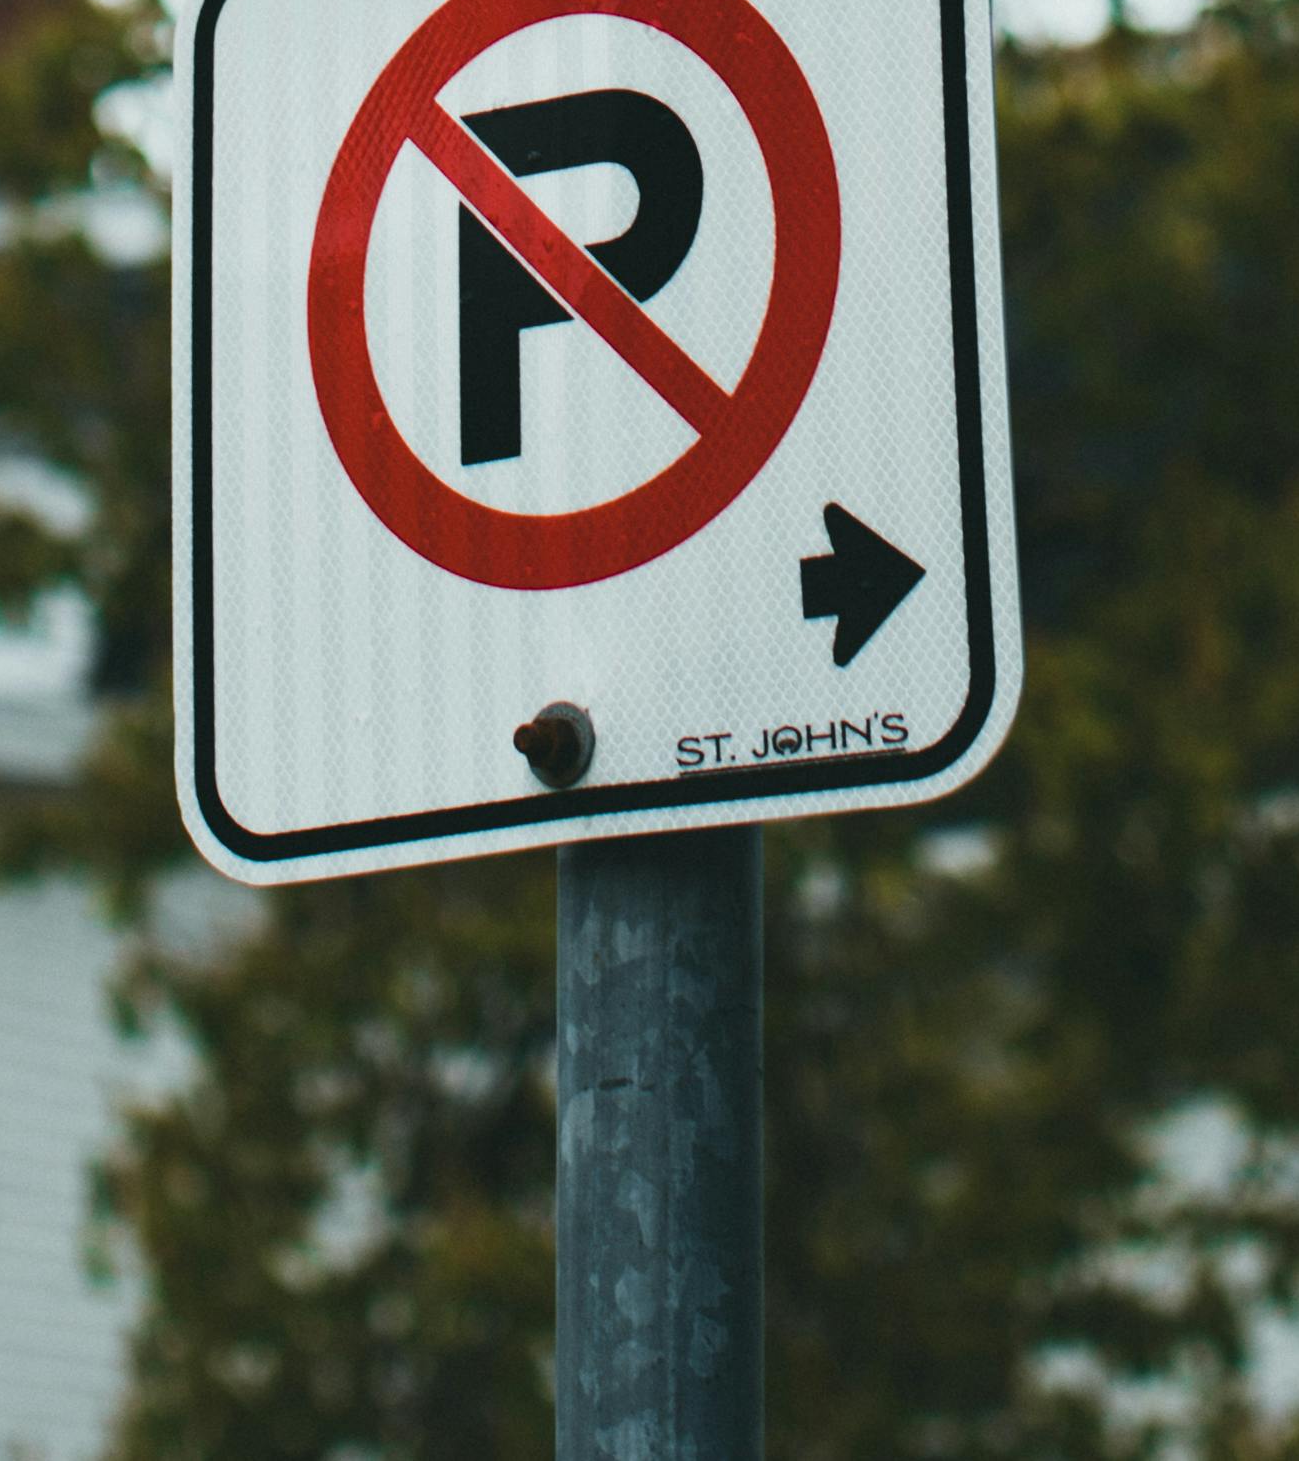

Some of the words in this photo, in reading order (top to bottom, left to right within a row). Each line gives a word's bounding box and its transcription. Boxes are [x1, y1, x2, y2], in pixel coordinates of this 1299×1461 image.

[458, 86, 705, 467] P
[675, 732, 737, 768] ST.
[751, 711, 910, 759] JOHN'S
